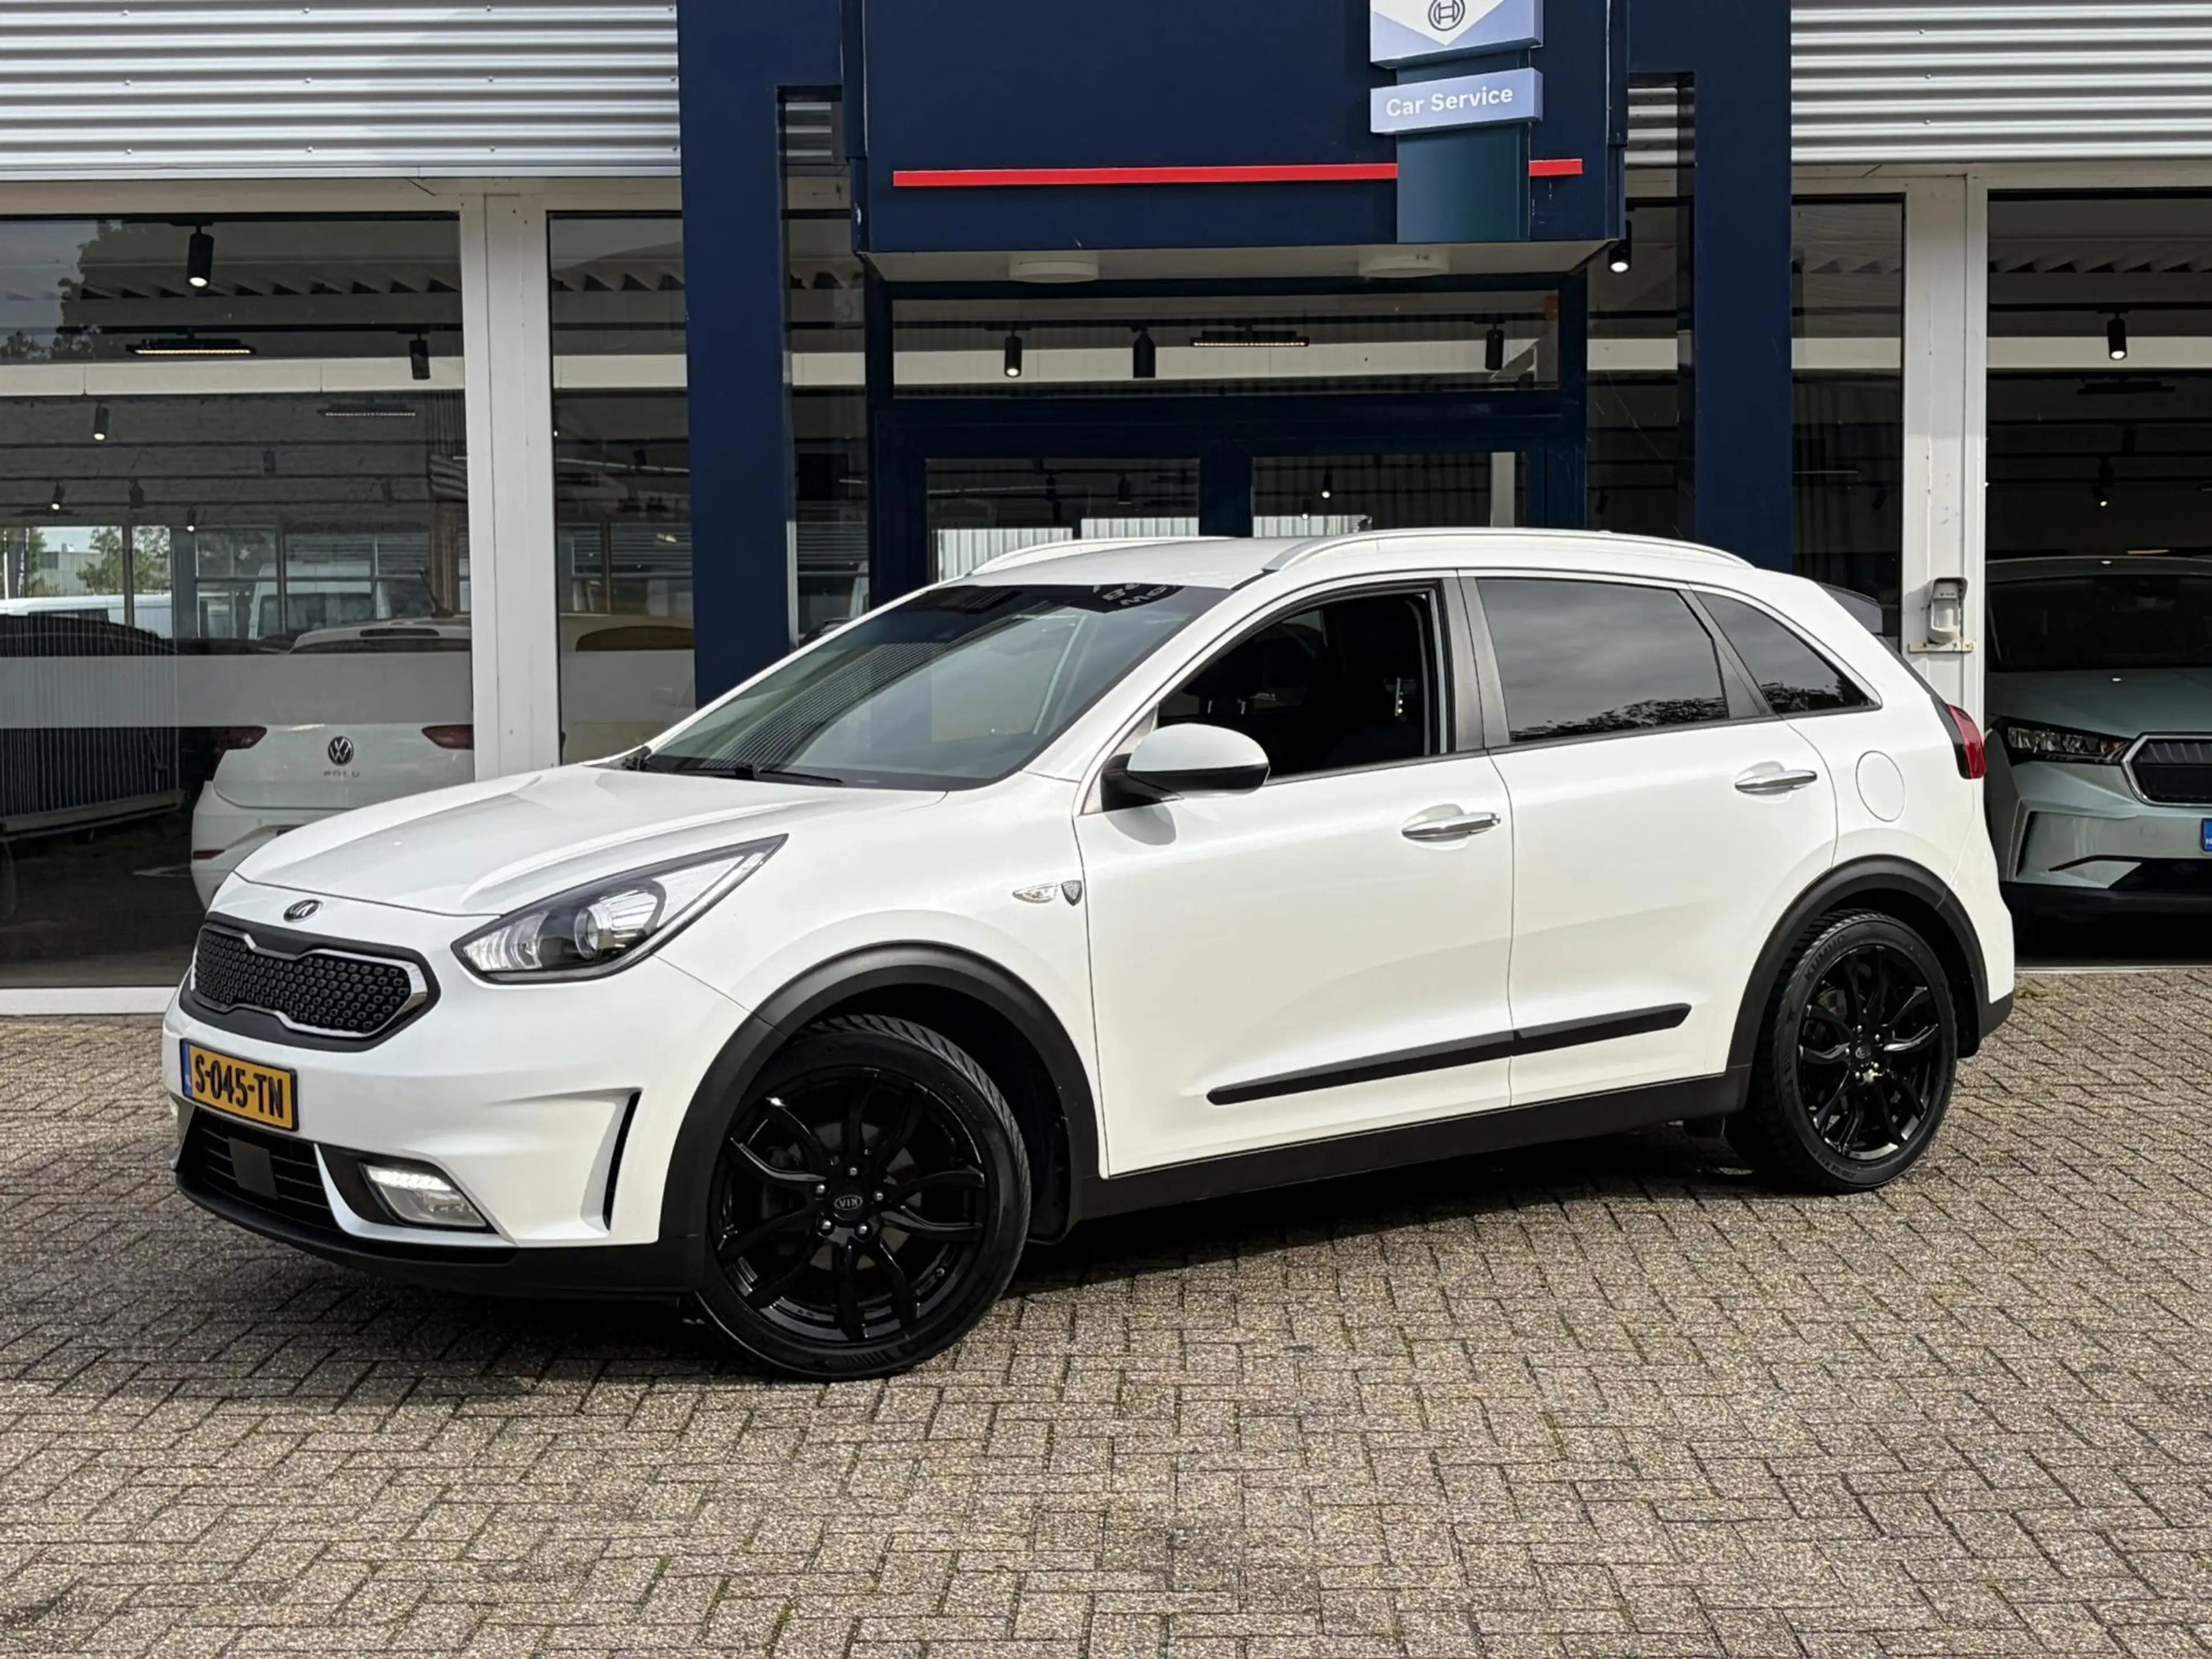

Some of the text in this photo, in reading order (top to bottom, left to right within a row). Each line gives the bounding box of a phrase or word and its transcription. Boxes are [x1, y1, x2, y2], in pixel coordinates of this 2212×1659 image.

[1386, 86, 1513, 118] Car Service
[194, 1054, 283, 1119] S-045-TN
